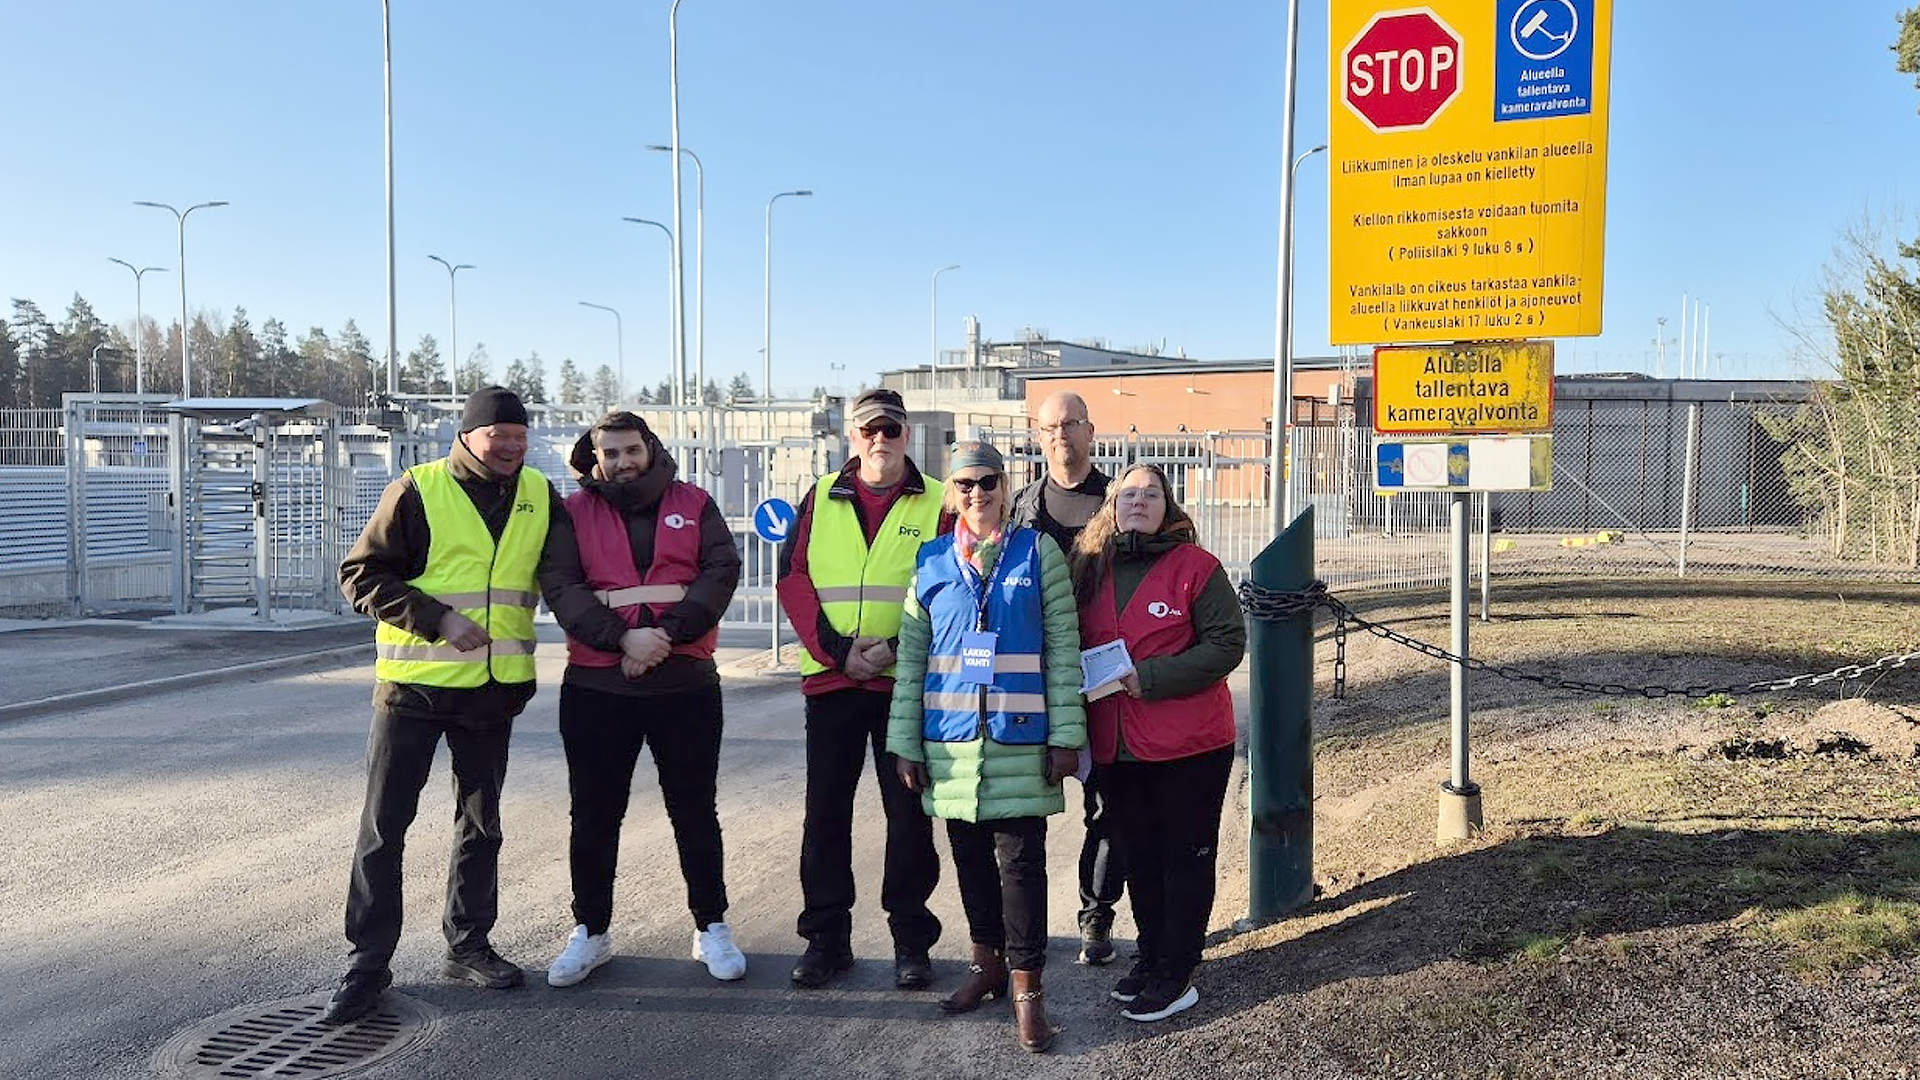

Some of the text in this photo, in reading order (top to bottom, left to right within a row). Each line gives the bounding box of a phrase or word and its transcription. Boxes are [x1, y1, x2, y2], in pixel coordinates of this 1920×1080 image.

[1351, 46, 1454, 97] STOP
[1520, 66, 1565, 82] Alueella
[1517, 83, 1571, 98] tallentava
[1501, 96, 1587, 115] kameravalvonta
[1342, 140, 1593, 174] Liikkuminen ja oleskelu vankilan alueella
[1393, 165, 1535, 188] ilman lupaa on kielletty
[1353, 199, 1579, 227] Kiellon rikkomisesta voidaan tuomita
[1437, 226, 1487, 239] sakkoon
[1400, 244, 1457, 259] Poliisilaki
[1462, 243, 1469, 256] 9
[1473, 242, 1499, 255] luku
[1504, 240, 1512, 254] 8
[1350, 274, 1581, 297] Vankilalla on oikeus tarkastaa vankila-
[1350, 292, 1582, 315] alueella liikkuvat henkilöt ja ajoneuvot
[1394, 315, 1465, 330] Vankeuslaki
[1468, 314, 1480, 327] 17
[1485, 313, 1510, 327] luku
[1515, 312, 1522, 325] 2
[1423, 355, 1502, 374] Alueella
[1415, 379, 1509, 398] tallentava
[1387, 402, 1539, 422] kameravalvonta
[964, 657, 990, 668] VAHTI
